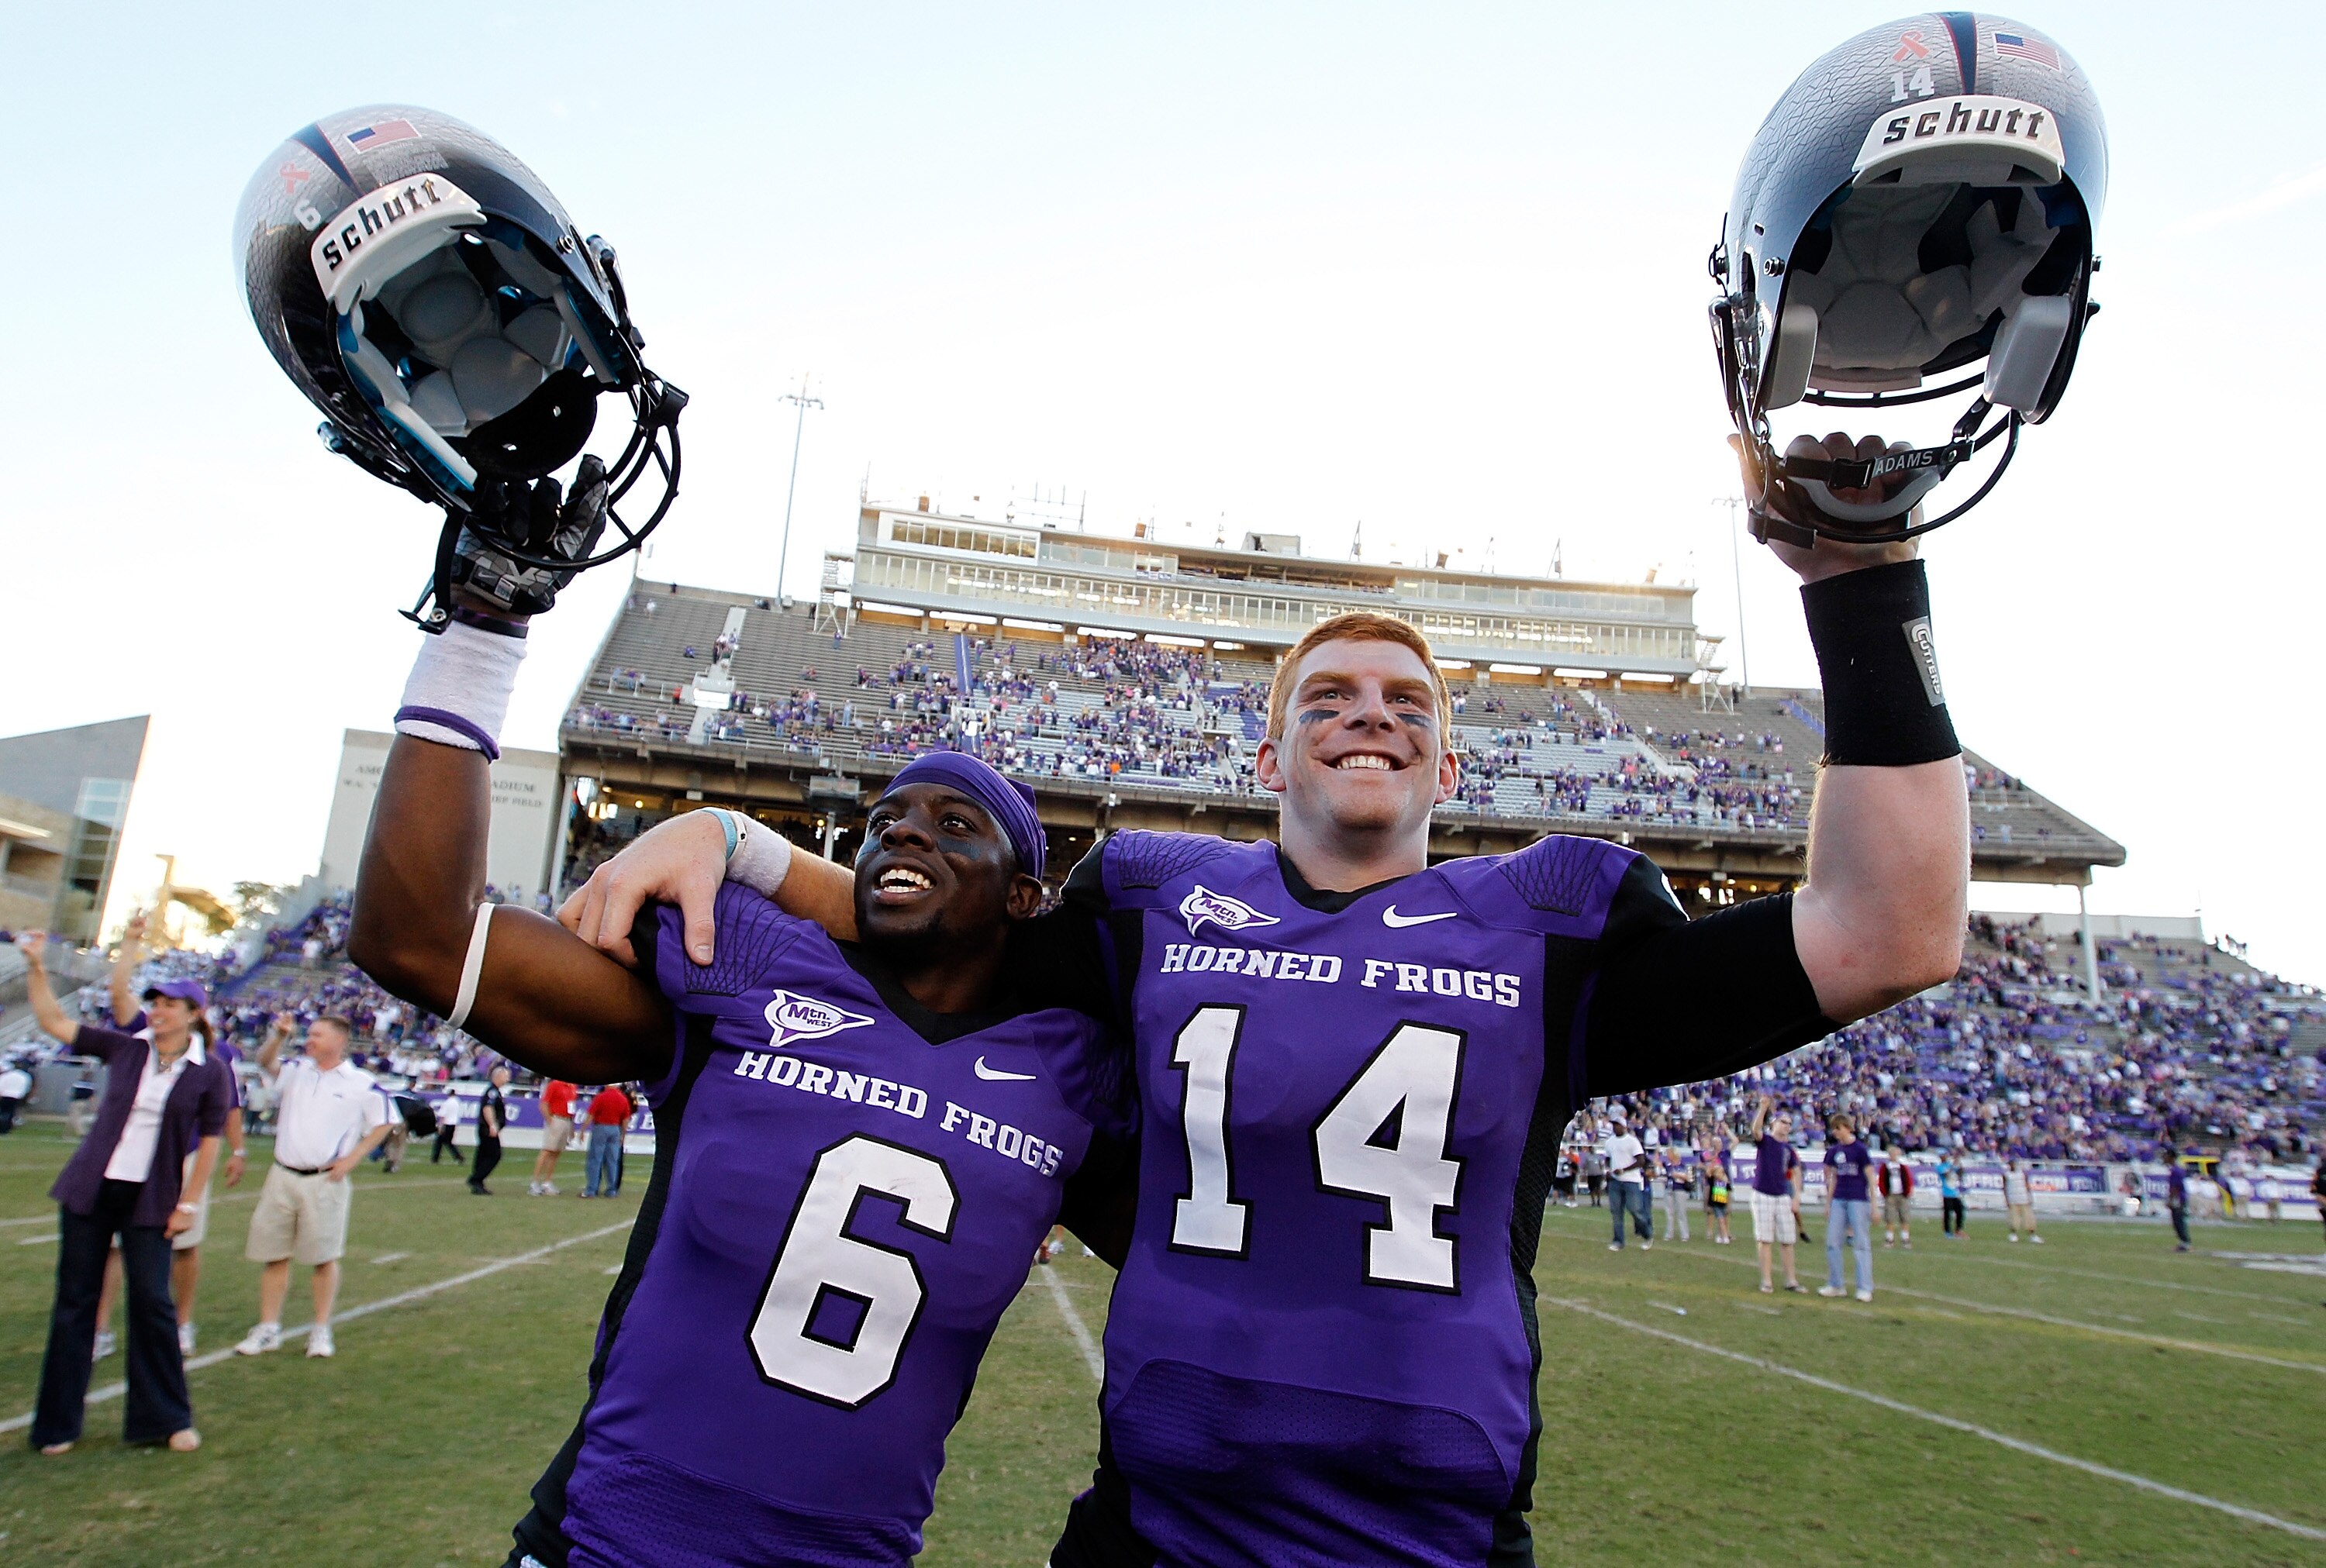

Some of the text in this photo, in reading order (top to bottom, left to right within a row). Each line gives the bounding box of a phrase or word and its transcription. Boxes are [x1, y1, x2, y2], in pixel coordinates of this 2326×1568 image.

[1889, 67, 1935, 102] 14
[1883, 102, 2045, 145] schutt
[294, 198, 322, 232] 6
[322, 178, 441, 271] schutt
[1874, 450, 1934, 476] ADAMS
[1910, 622, 1941, 694] CUTTERS
[1199, 898, 1238, 919] Mtn.
[1213, 912, 1238, 925] WEST
[1160, 943, 1522, 1008] HORNED FROGS
[787, 1004, 830, 1020] Mtn.
[806, 1018, 833, 1028] WEST
[733, 1050, 1064, 1178] HORNED FROGS
[1169, 1003, 1468, 1294] 14
[745, 1132, 961, 1411] 6
